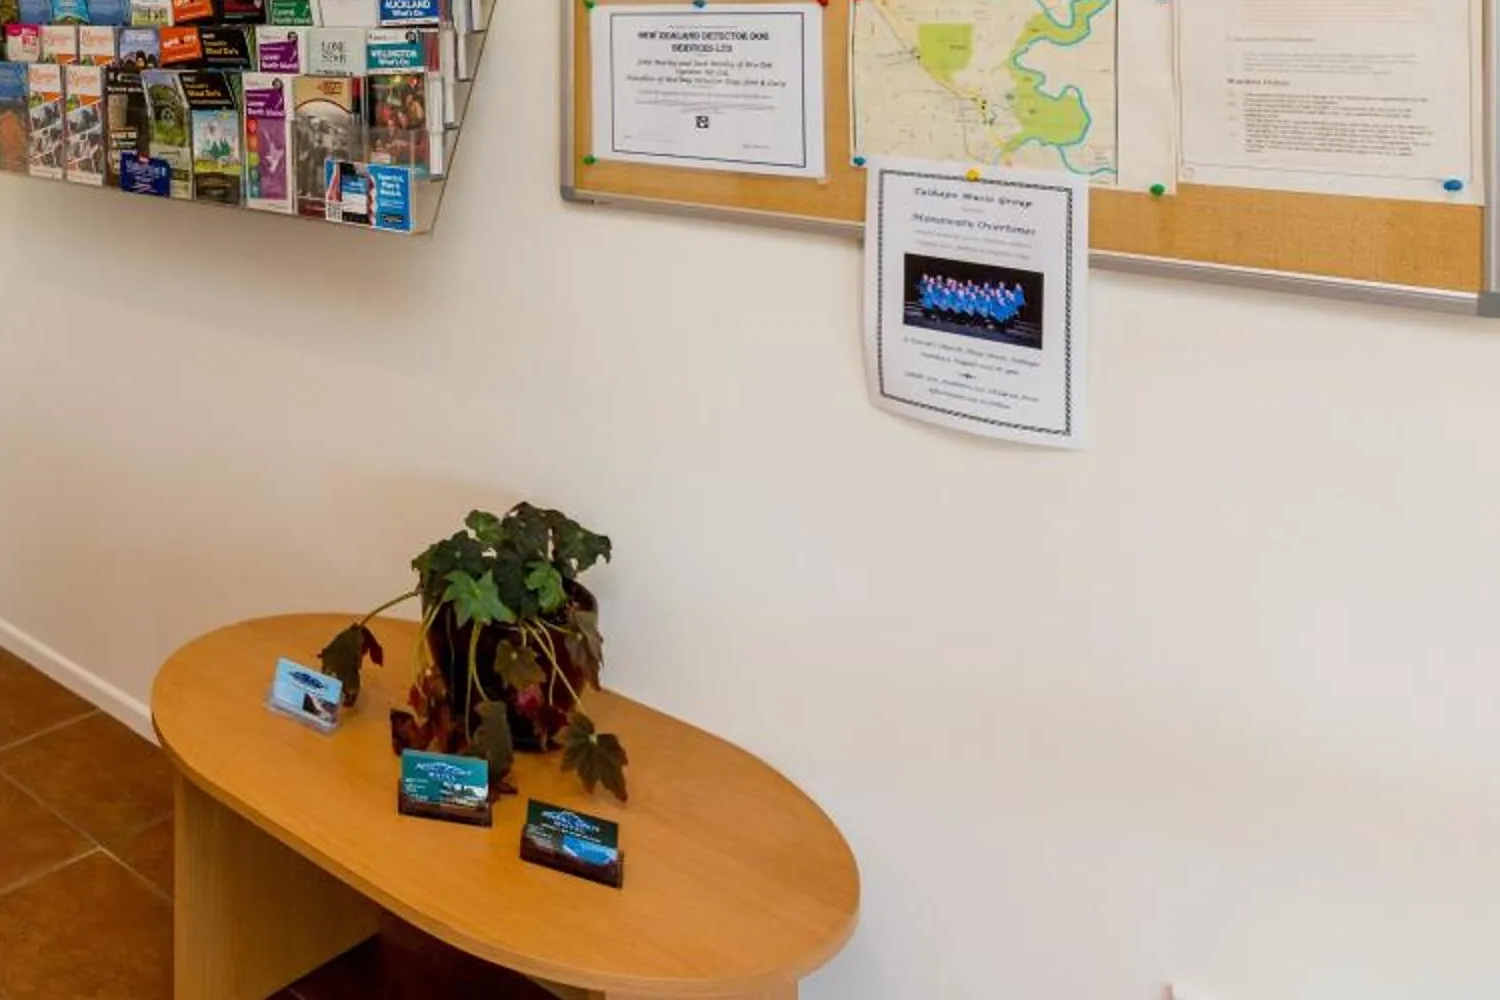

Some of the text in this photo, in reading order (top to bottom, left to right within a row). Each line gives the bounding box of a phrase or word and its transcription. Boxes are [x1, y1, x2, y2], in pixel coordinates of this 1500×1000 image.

[384, 0, 431, 9] AUCKLAND
[392, 9, 414, 17] What's
[659, 31, 700, 40] ZEALAND
[702, 31, 748, 40] DETECTOR
[371, 49, 418, 58] WELLINGTON
